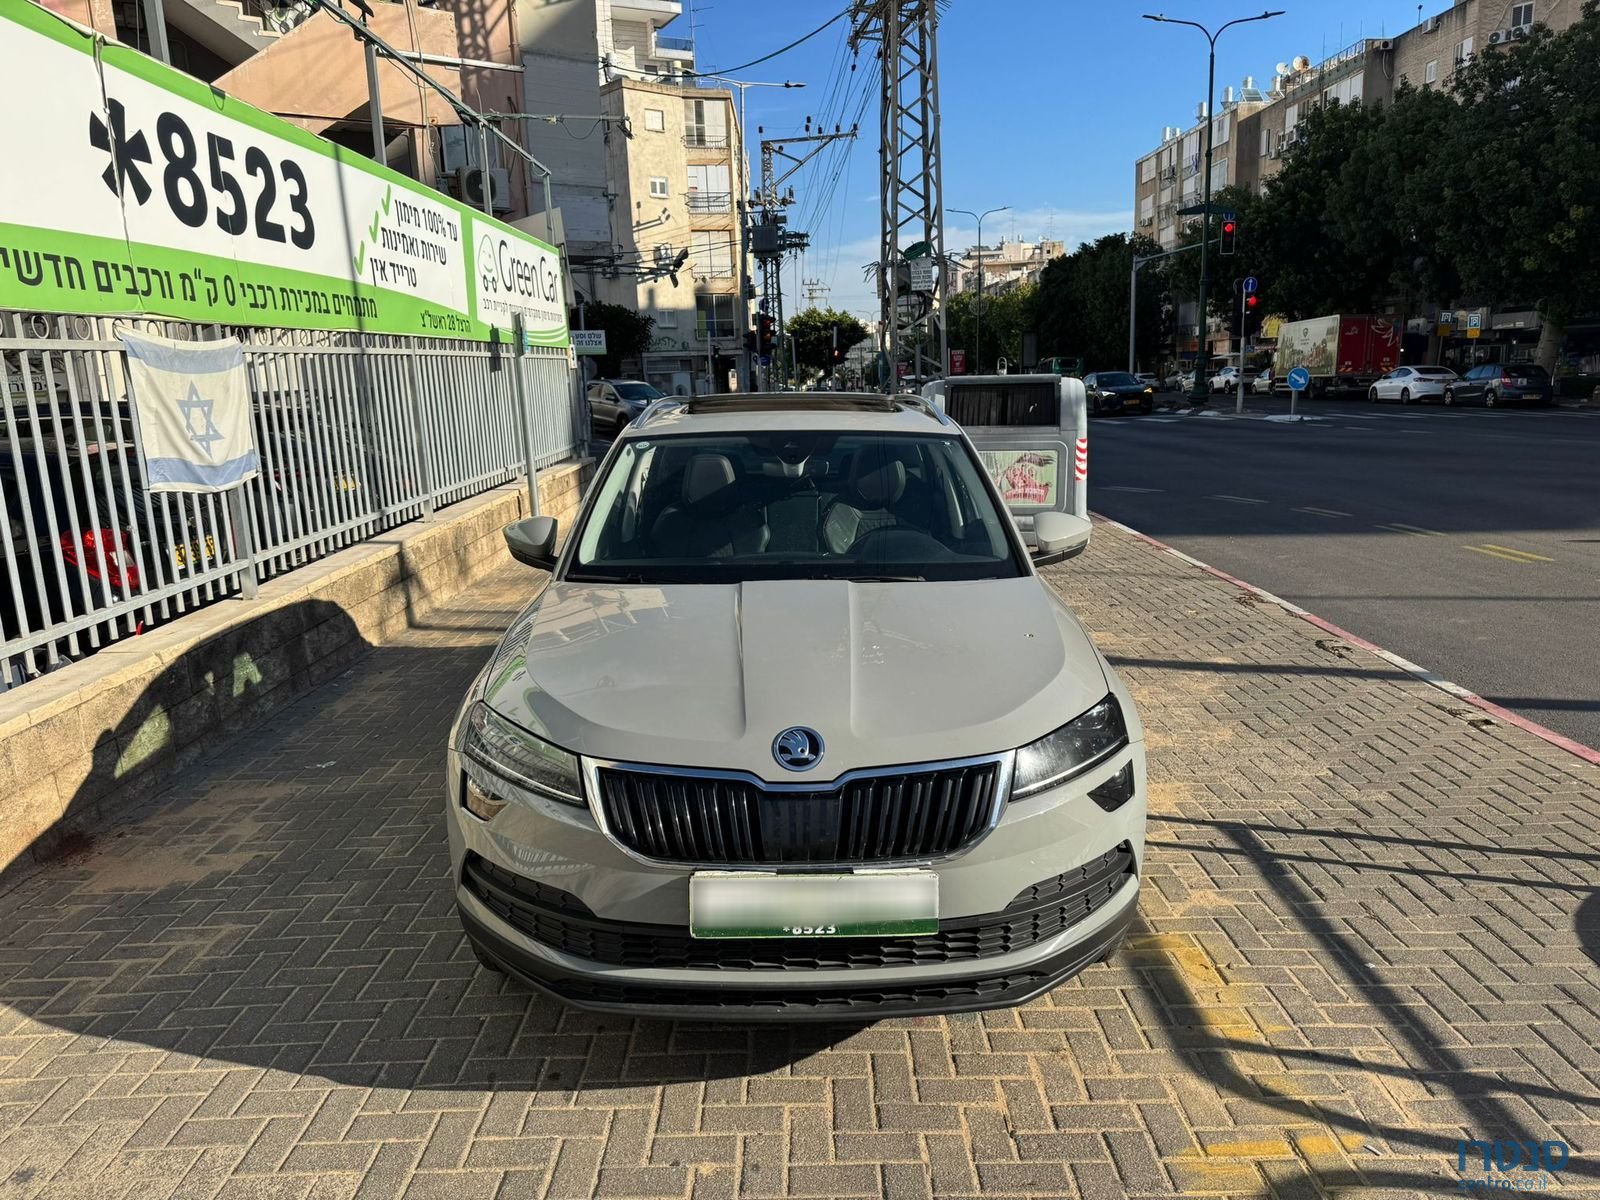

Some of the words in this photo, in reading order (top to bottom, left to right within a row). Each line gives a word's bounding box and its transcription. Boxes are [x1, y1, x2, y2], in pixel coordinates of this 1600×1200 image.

[394, 199, 421, 228] מימון
[422, 208, 446, 238] 100%
[381, 226, 419, 258] ואמינות
[447, 221, 458, 241] עד
[420, 240, 447, 265] שירות
[92, 260, 174, 299] ורכבים
[370, 257, 388, 287] אין
[389, 262, 417, 287] טרייד
[498, 239, 540, 299] Green
[540, 256, 559, 304] Car
[179, 267, 218, 307] ק"מ
[223, 274, 236, 307] 0
[239, 282, 277, 310] רכבי
[279, 287, 331, 314] במכירת
[332, 293, 378, 318] מתמחים
[420, 309, 447, 330] ראשל"צ
[447, 314, 456, 331] 28
[455, 315, 472, 332] הרצל
